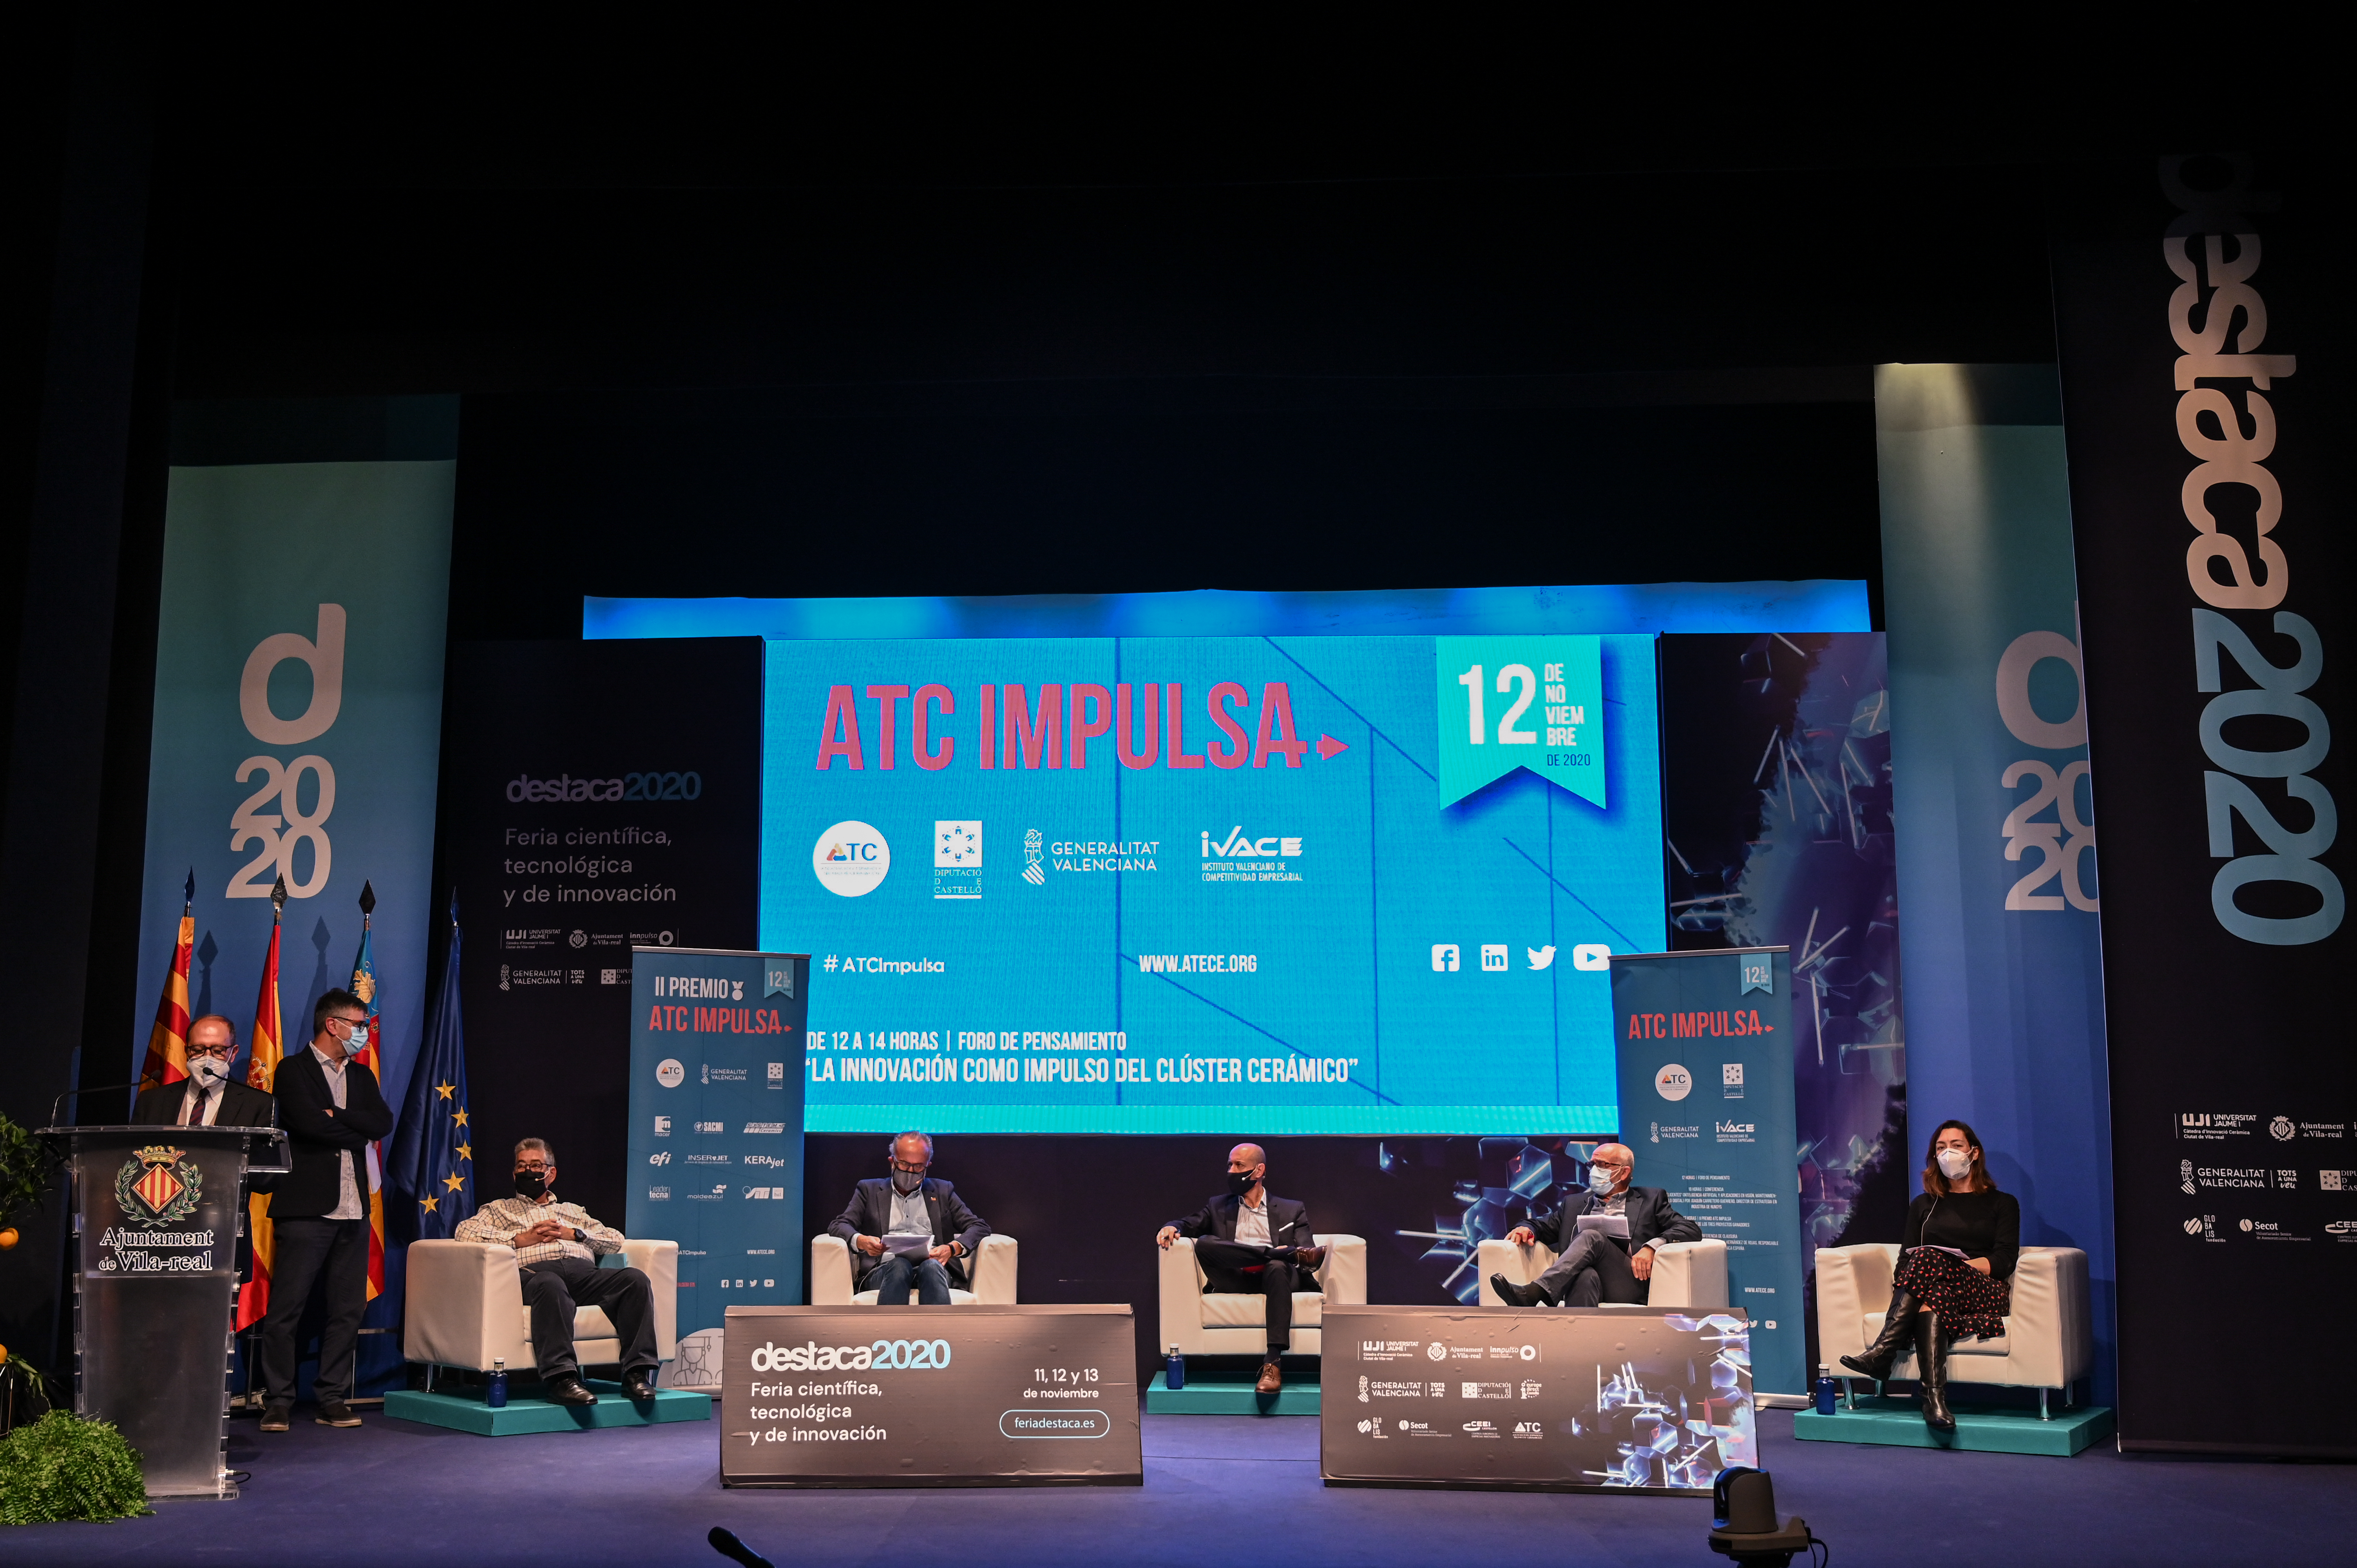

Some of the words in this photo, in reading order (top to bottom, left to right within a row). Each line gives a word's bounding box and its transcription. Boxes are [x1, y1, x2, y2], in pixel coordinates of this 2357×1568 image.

[240, 603, 346, 744] d
[1544, 663, 1564, 682] DE
[1545, 684, 1566, 703] NO
[1459, 664, 1537, 744] 12
[1545, 706, 1584, 724] VIEM
[816, 684, 954, 770] ATC
[980, 683, 1307, 770] IMPULSA
[1547, 727, 1577, 746] BRE
[1547, 754, 1560, 766] DE
[1564, 754, 1590, 766] 2020
[230, 755, 335, 828] 20
[506, 771, 701, 802] destaca2020
[506, 828, 557, 845] Feria
[566, 827, 671, 846] científica,
[826, 843, 877, 861] ATC
[1052, 841, 1160, 855] GENERALITAT
[226, 826, 331, 898] 20
[505, 855, 632, 878] tecnológica
[1053, 858, 1157, 871] VALENCIANA
[1202, 863, 1234, 871] INSTITUTO
[1236, 863, 1275, 871] VALENCIANO
[1202, 873, 1256, 881] COMPETITIVIDAD
[1259, 873, 1303, 881] EMPRESARIAL
[503, 890, 516, 907] y
[523, 885, 550, 902] de
[558, 884, 675, 901] innovación
[842, 957, 944, 975] ATCImpulsa
[1139, 955, 1256, 973] WWW.ATECE.ORG
[769, 971, 782, 987] 12
[1745, 967, 1760, 983] 12
[655, 977, 664, 996] II
[670, 977, 728, 998] PREMIO
[649, 1006, 688, 1031] ATC
[694, 1007, 782, 1034] IMPULSA
[1629, 1013, 1666, 1039] ATC
[1672, 1010, 1762, 1038] IMPULSA
[807, 1031, 826, 1050] DE
[832, 1032, 849, 1050] 12
[853, 1032, 863, 1049] A
[869, 1032, 886, 1050] 14
[890, 1031, 939, 1050] HORAS
[959, 1032, 996, 1050] FORO
[1000, 1032, 1019, 1050] DE
[1023, 1031, 1126, 1051] PENSAMIENTO
[841, 1053, 958, 1082] INNOVACIÓN
[963, 1058, 1018, 1082] COMO
[1025, 1058, 1109, 1082] IMPULSO
[1115, 1058, 1151, 1082] DEL
[1157, 1054, 1242, 1082] CLÚSTER
[1662, 1074, 1686, 1083] ATC
[704, 1122, 723, 1131] SACMI
[2300, 1122, 2344, 1131] Ajuntament
[650, 1152, 671, 1166] efi
[745, 1156, 784, 1168] KERAjet
[2198, 1168, 2265, 1177] GENERALITAT
[2199, 1178, 2265, 1188] VALENCIANA
[2204, 1215, 2215, 1223] GLO
[2255, 1222, 2278, 1230] Secot
[100, 1227, 214, 1250] Ajuntament
[99, 1257, 116, 1270] de
[115, 1251, 212, 1271] Vila-real
[751, 1340, 950, 1371] destaca2020
[1490, 1346, 1519, 1355] innpulso
[1035, 1369, 1048, 1383] 11,
[1052, 1369, 1066, 1381] 12
[1071, 1372, 1080, 1385] y
[1084, 1369, 1098, 1381] 13
[752, 1382, 792, 1396] Feria
[798, 1380, 882, 1396] científica,
[1024, 1388, 1037, 1398] de
[1041, 1388, 1099, 1398] noviembre
[750, 1403, 851, 1422] tecnológica
[1015, 1417, 1094, 1428] feriadestaca.es
[1515, 1422, 1541, 1432] ATC
[749, 1432, 760, 1445] y
[766, 1427, 787, 1441] de
[793, 1425, 886, 1441] innovación
